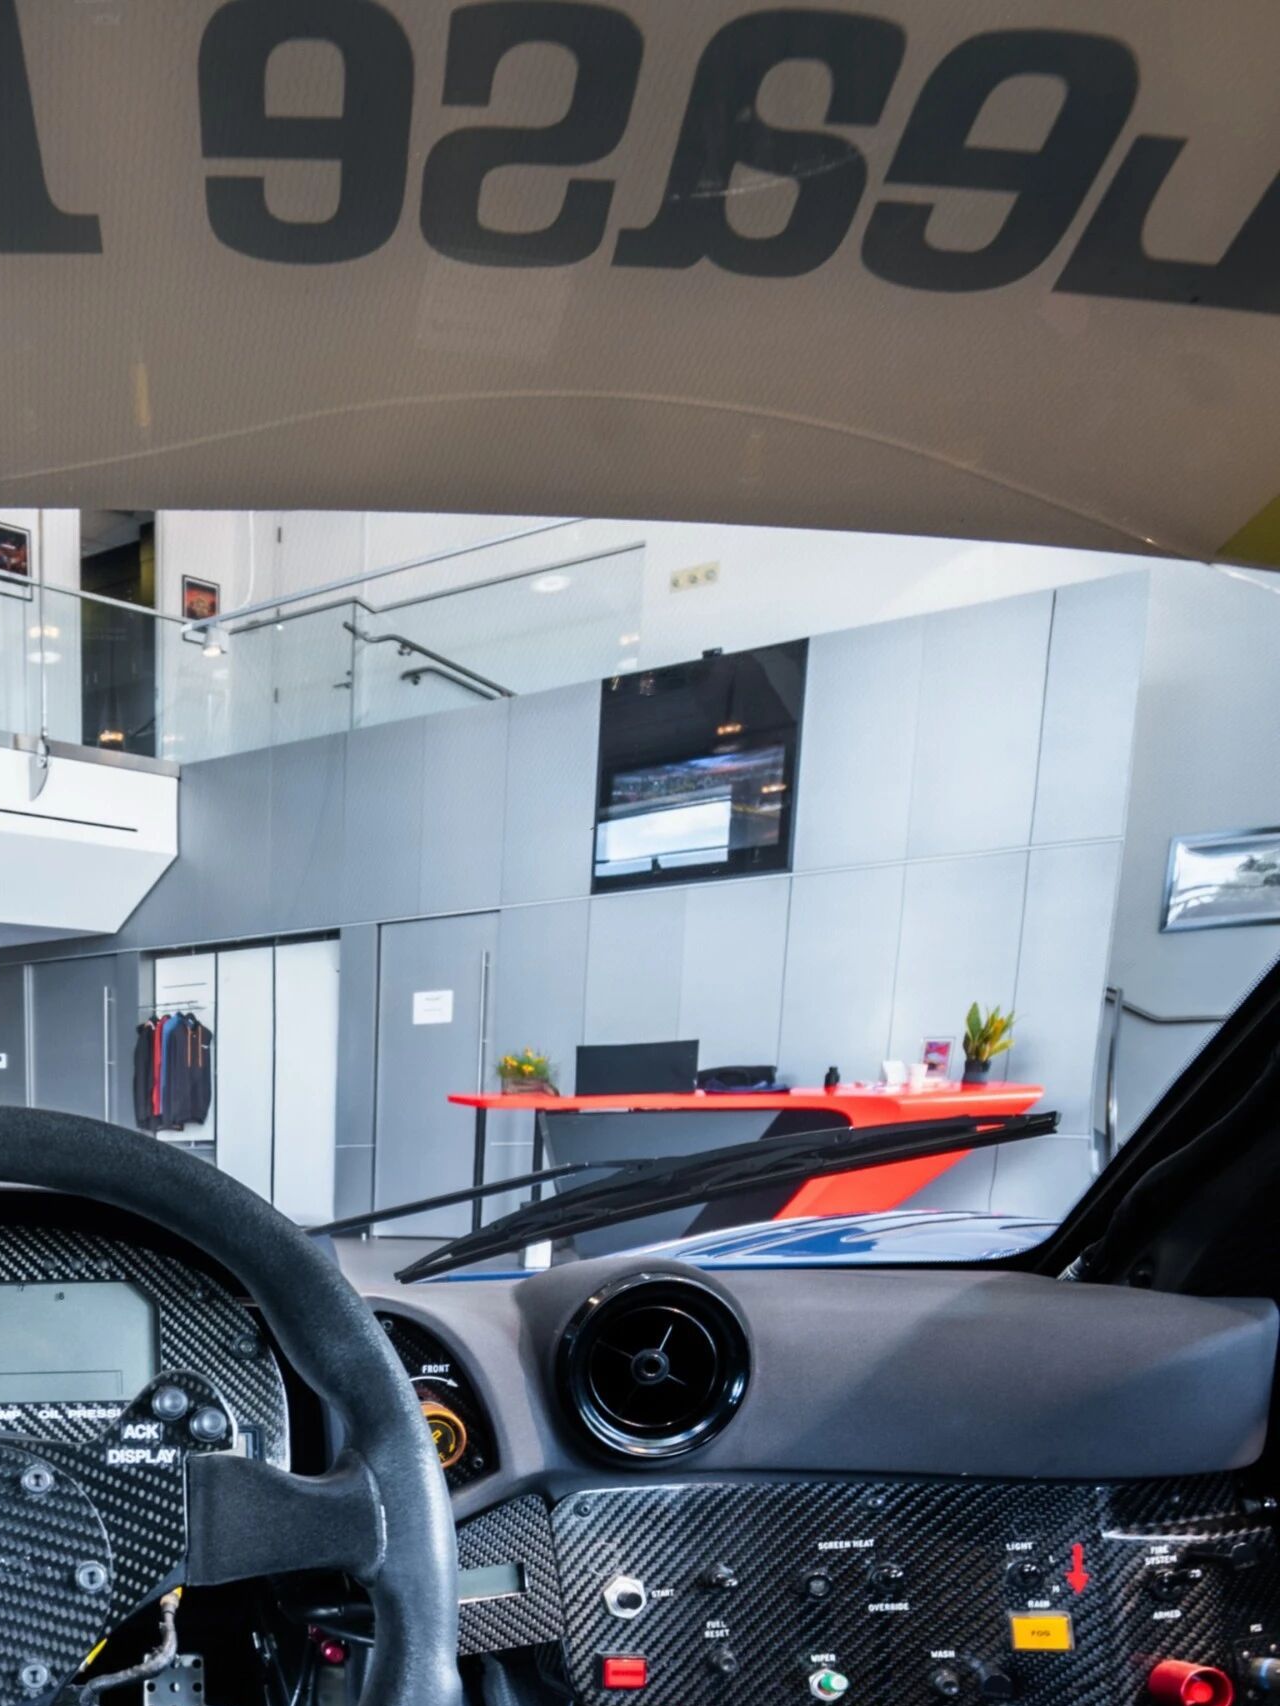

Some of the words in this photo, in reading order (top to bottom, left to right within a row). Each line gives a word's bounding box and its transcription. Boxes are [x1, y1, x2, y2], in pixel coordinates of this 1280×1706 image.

[422, 1363, 450, 1374] FRONT
[38, 1410, 63, 1420] OIL
[123, 1423, 159, 1439] ACK
[106, 1448, 177, 1465] DISPLAY
[818, 1541, 851, 1550] SCREEN
[853, 1539, 875, 1548] HEAT
[1006, 1542, 1033, 1551] LIGHT
[1145, 1554, 1177, 1565] SYSTEM
[651, 1588, 675, 1598] START
[868, 1603, 910, 1612] OVERRIDE
[1153, 1609, 1181, 1619] ARMED
[704, 1629, 730, 1638] RESET
[811, 1654, 836, 1663] WIPER
[930, 1650, 955, 1658] WASH
